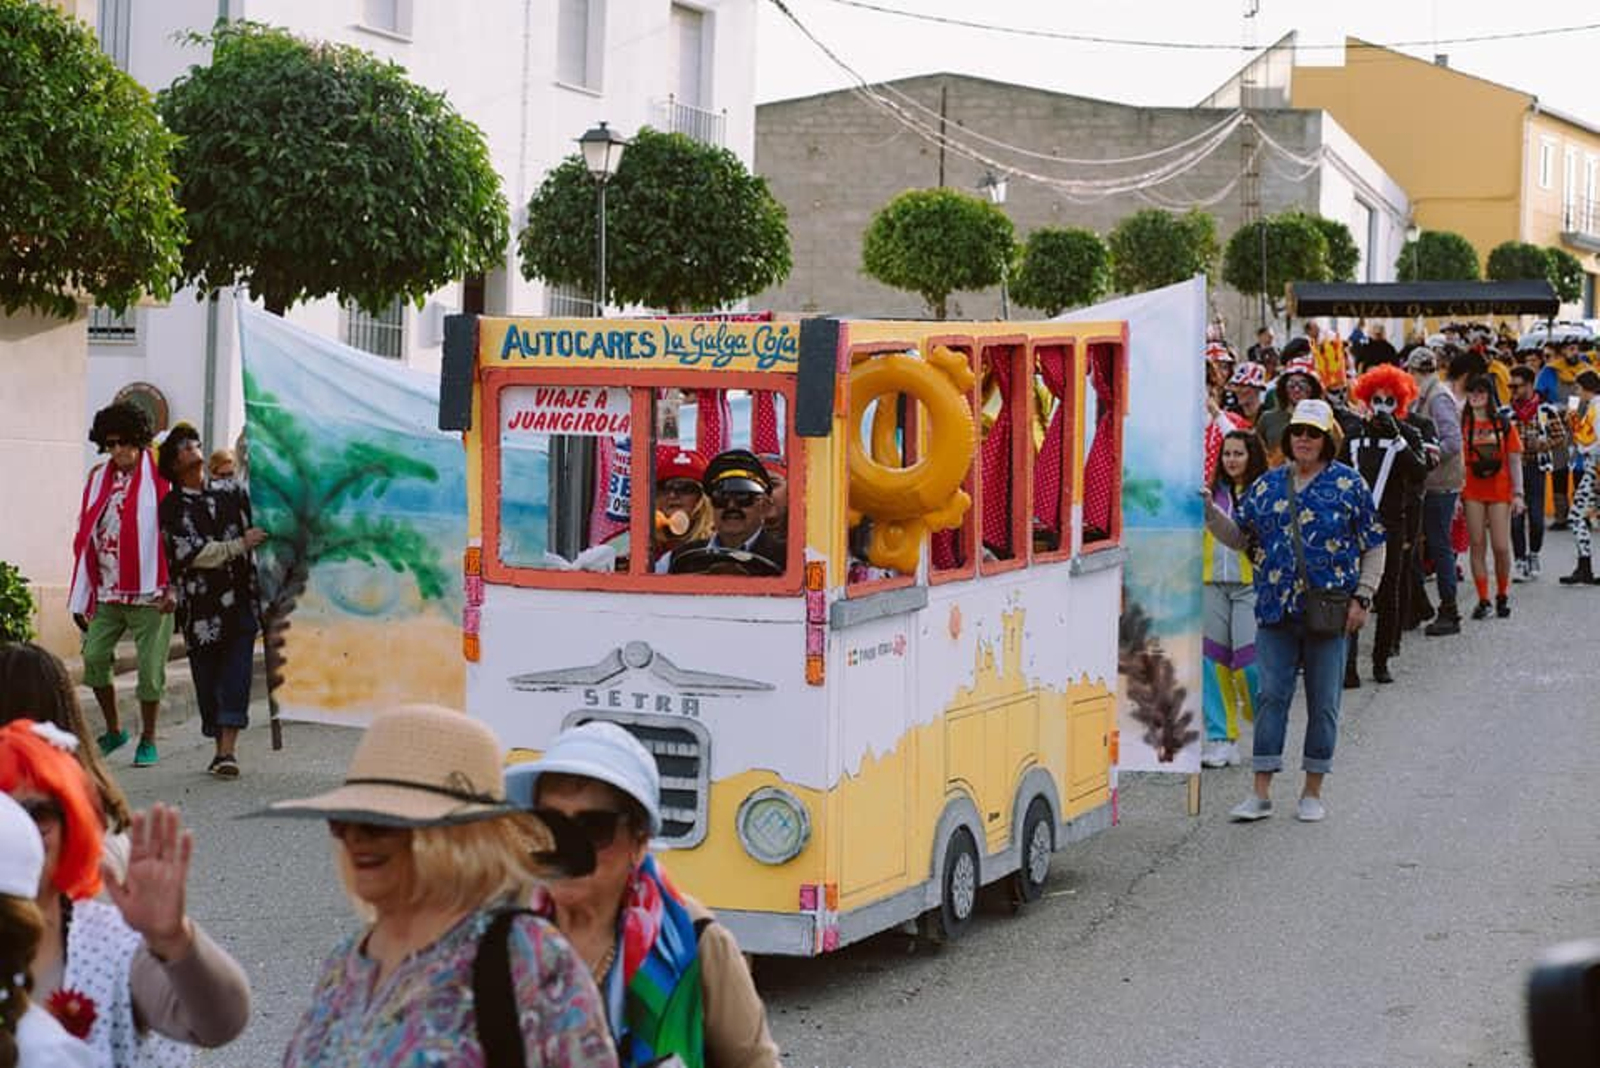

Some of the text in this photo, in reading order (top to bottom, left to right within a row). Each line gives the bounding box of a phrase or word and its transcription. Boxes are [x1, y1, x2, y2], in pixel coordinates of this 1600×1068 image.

[501, 323, 799, 369] AUTOCARES La Galga Coja
[534, 387, 609, 409] VIAJE A
[508, 409, 631, 434] JUANGIROLA
[584, 688, 700, 716] SETRA
